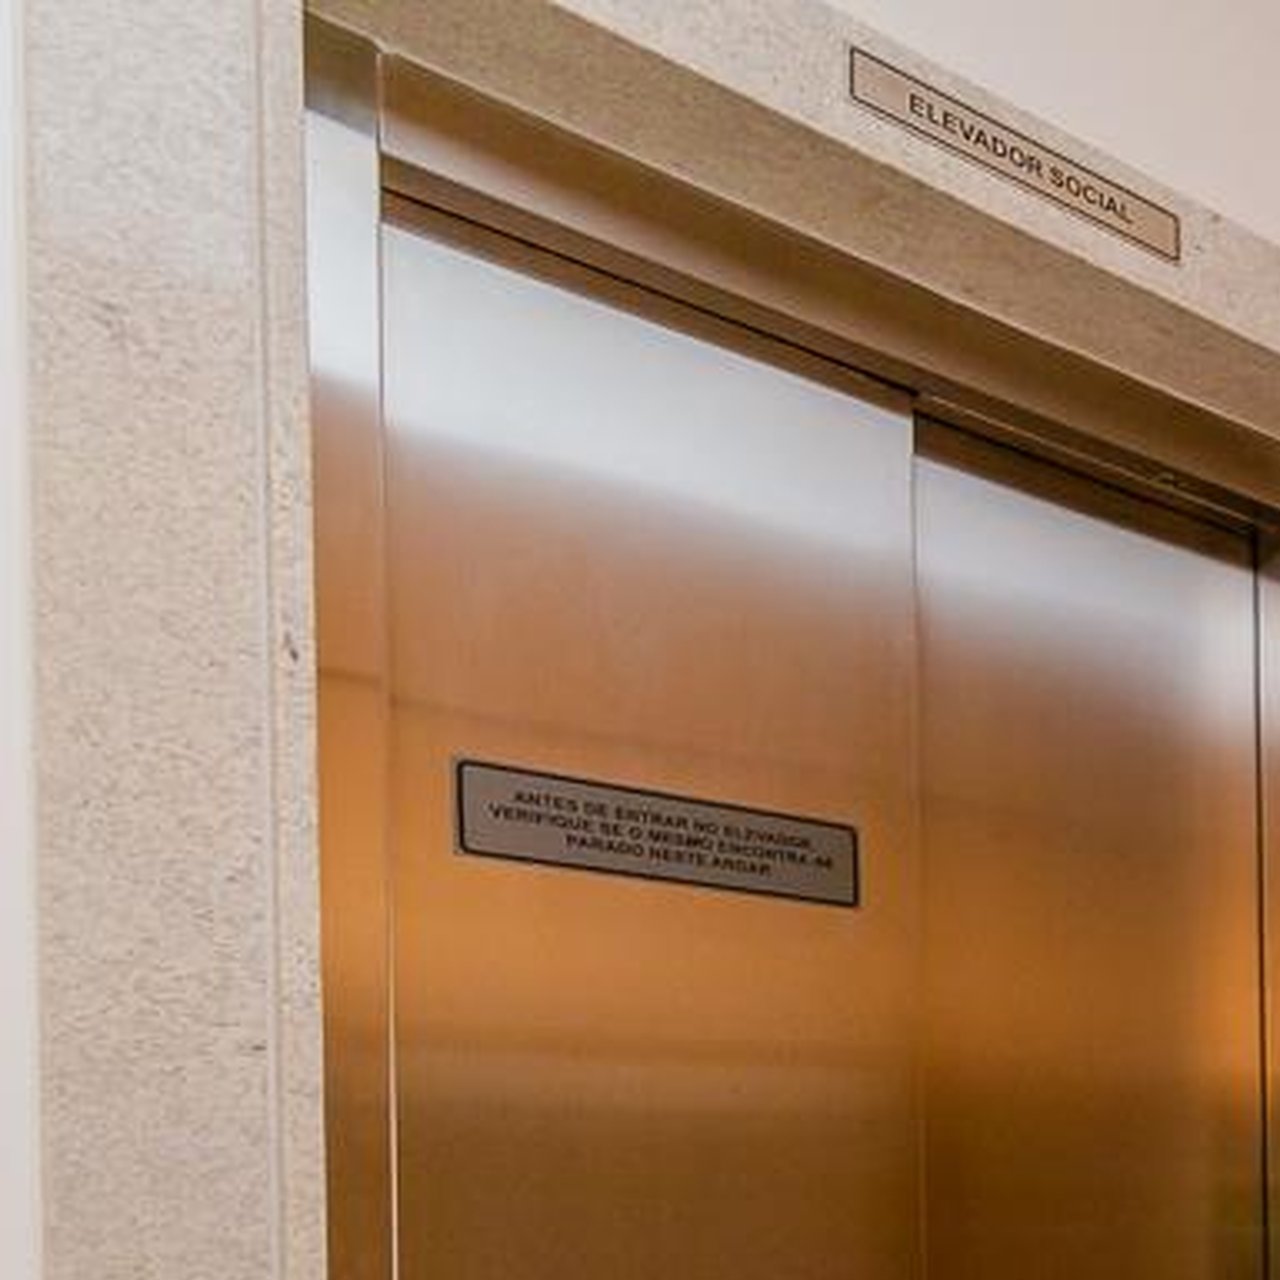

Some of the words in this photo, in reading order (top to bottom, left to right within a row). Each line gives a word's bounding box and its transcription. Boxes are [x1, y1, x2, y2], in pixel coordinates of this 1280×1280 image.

[908, 92, 1044, 179] ELEVADOR
[1049, 166, 1133, 223] SOCIAL
[488, 801, 592, 830] VERIFIQUE
[599, 822, 622, 837] SE
[627, 826, 643, 840] O
[648, 828, 715, 850] MESMO
[514, 791, 579, 813] ANTES
[583, 800, 607, 818] DE
[615, 805, 688, 829] ENTRAR
[693, 819, 720, 834] NO
[565, 834, 644, 857] PARADO
[650, 847, 706, 867] NESTE
[712, 855, 772, 876] ANDAR
